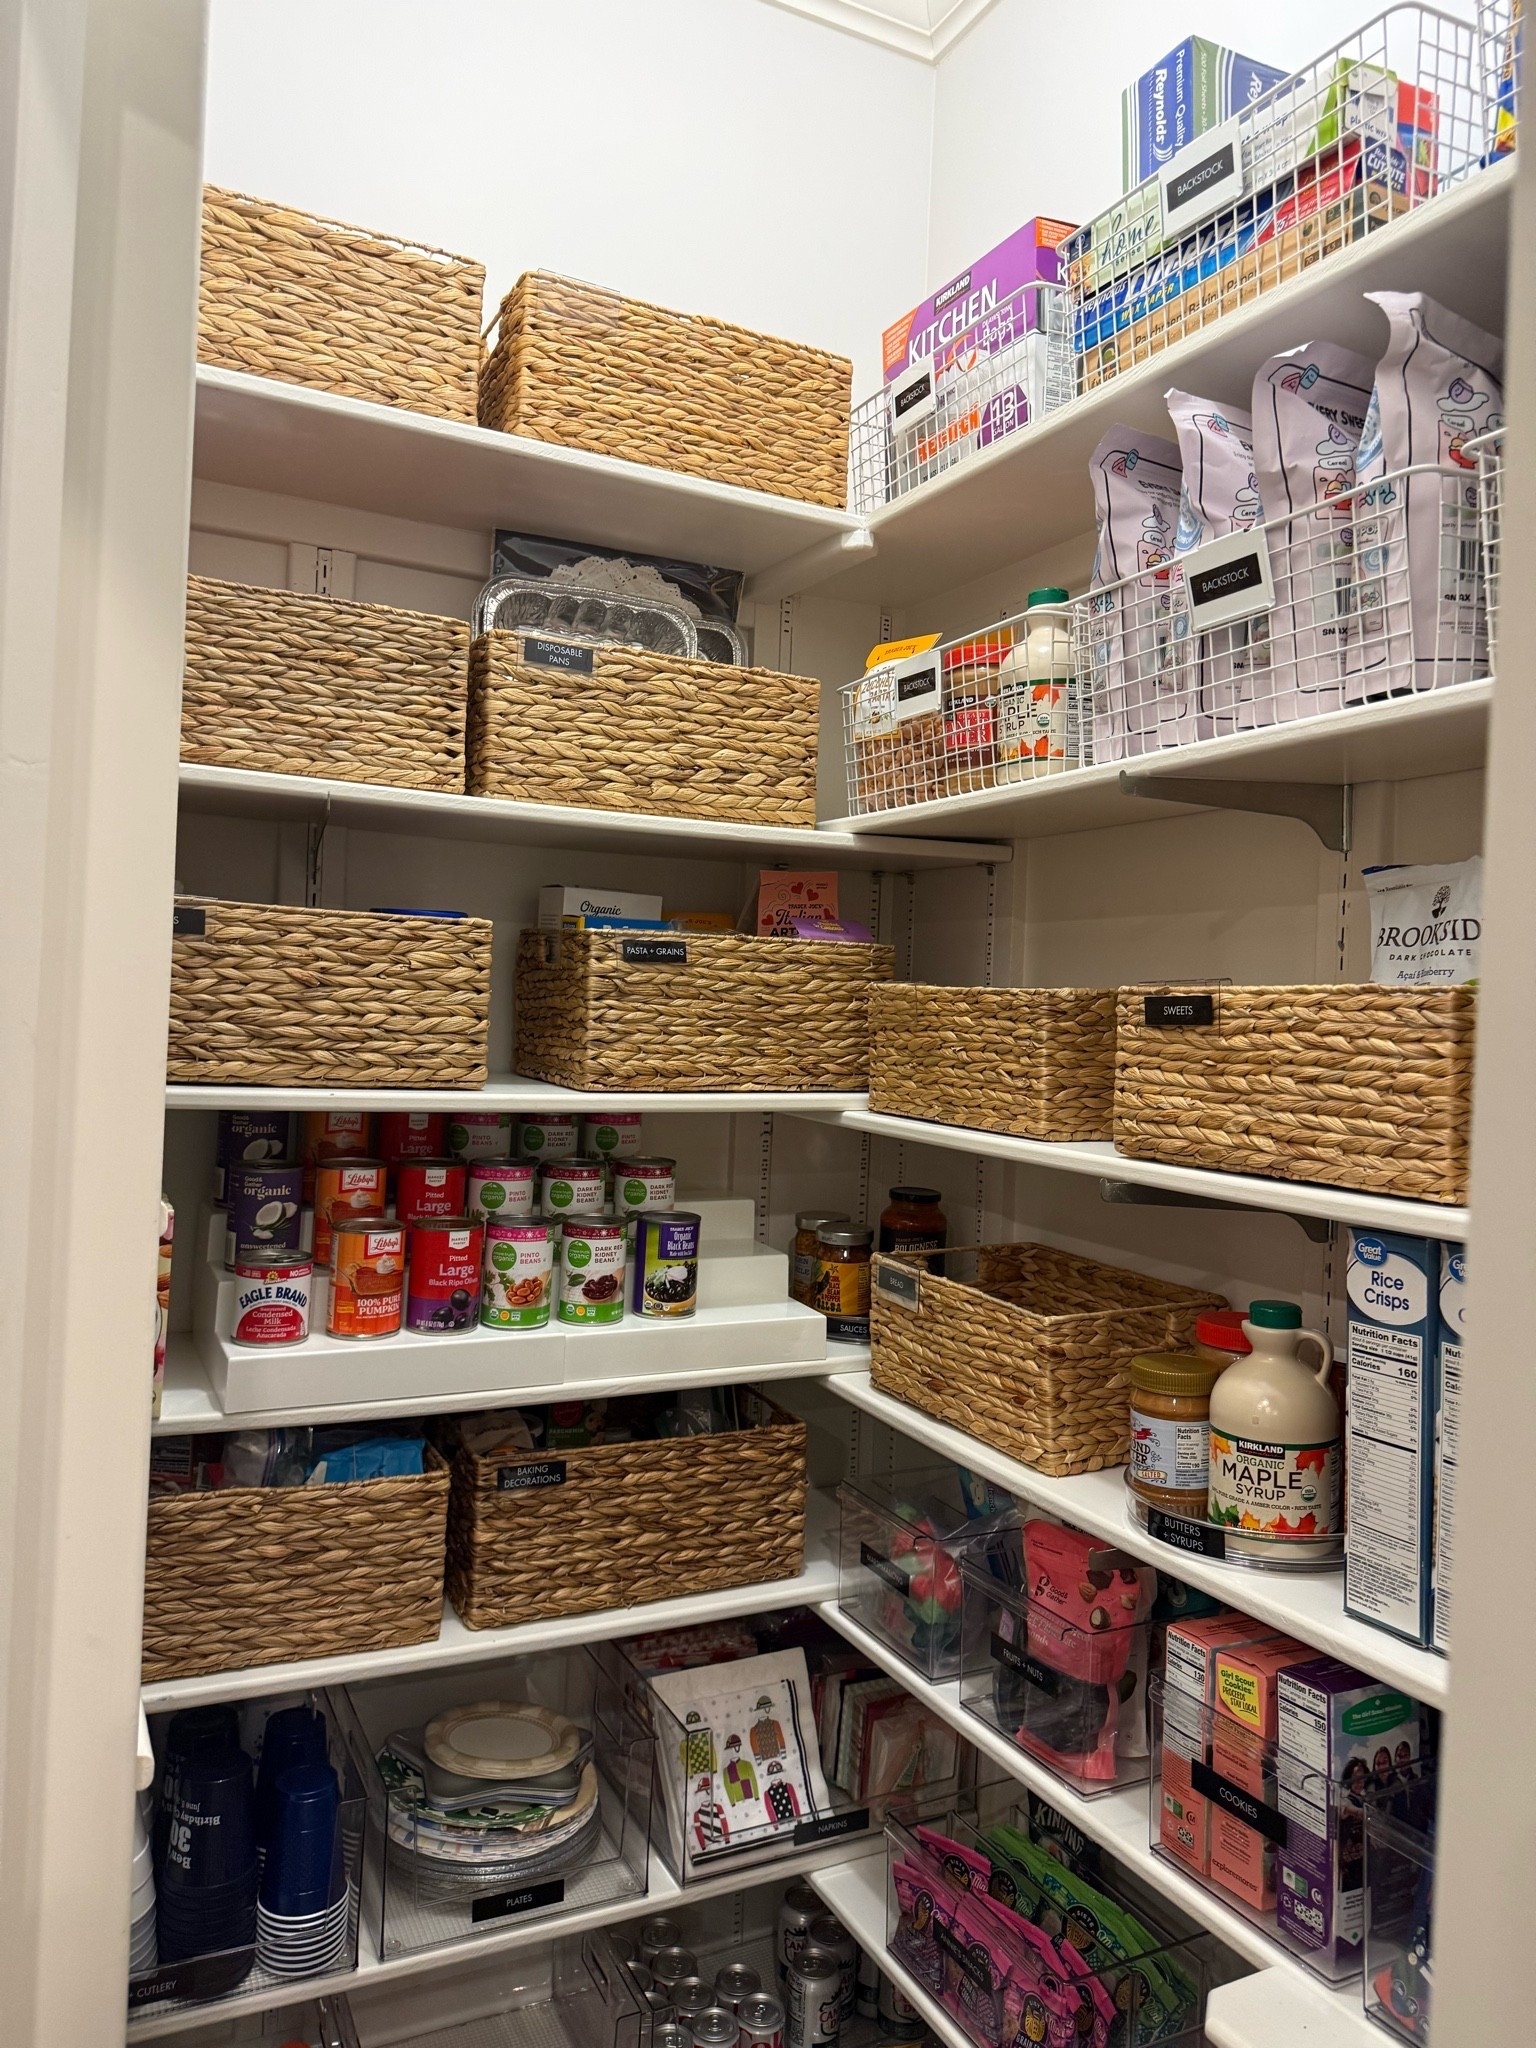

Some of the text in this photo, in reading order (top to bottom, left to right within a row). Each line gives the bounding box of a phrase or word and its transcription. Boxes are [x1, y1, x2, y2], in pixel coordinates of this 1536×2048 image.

[1174, 48, 1186, 146] Premium Quality
[1155, 68, 1167, 146] Reynolds
[1177, 160, 1224, 196] BACKSTOCK
[1101, 213, 1158, 265] home
[936, 275, 970, 307] KIRKLAND
[1080, 280, 1128, 315] Reynolds
[908, 278, 997, 365] KITCHEN
[900, 384, 926, 408] BACKSTOCK
[992, 391, 1015, 427] 13
[1149, 534, 1162, 543] Cereal
[1202, 566, 1250, 593] BACKSTOCK
[536, 641, 584, 658] DISPOSABLE
[549, 654, 570, 666] PANS
[903, 677, 930, 692] BACKSTOCK
[580, 900, 621, 917] Organic
[1376, 919, 1481, 947] BROOKSID
[626, 946, 648, 955] PASTA
[656, 946, 685, 956] GRAINS
[1163, 1004, 1194, 1017] SWEETS
[334, 1116, 360, 1127] Libby's
[231, 1124, 277, 1137] organic
[400, 1143, 433, 1155] Large
[346, 1173, 375, 1185] Libby's
[244, 1185, 292, 1200] organic
[624, 1191, 646, 1199] organic
[416, 1200, 451, 1213] Large
[373, 1236, 400, 1250] Libby's
[674, 1231, 692, 1242] Organic
[240, 1242, 286, 1250] unsweetened
[667, 1240, 695, 1250] Black Beans
[895, 1240, 938, 1252] BOLOGNESE
[1358, 1244, 1381, 1256] Great
[492, 1253, 516, 1262] organic
[1363, 1251, 1382, 1261] Value
[439, 1263, 474, 1278] Large
[428, 1278, 463, 1287] Black Ripe
[890, 1277, 904, 1289] BREAD
[1371, 1270, 1404, 1290] Rice
[239, 1287, 272, 1308] EAGLE
[276, 1287, 308, 1308] BRAND
[357, 1295, 401, 1307] 100% PURE
[825, 1294, 840, 1302] PEPPER
[1364, 1288, 1410, 1311] Crisps
[252, 1310, 293, 1318] Condensed
[358, 1304, 400, 1315] PUMPKIN
[264, 1317, 282, 1325] Milk
[840, 1324, 868, 1334] SAUCES
[1352, 1325, 1389, 1341] Nutrition
[1391, 1335, 1418, 1347] Facts
[1352, 1341, 1368, 1350] Serving
[1352, 1357, 1381, 1370] Calories
[1397, 1367, 1417, 1379] 160
[1238, 1440, 1284, 1454] KIRKLAND
[517, 1464, 549, 1475] BAKING
[1236, 1454, 1285, 1470] ORGANIC
[504, 1473, 561, 1488] DECORATIONS
[1222, 1460, 1303, 1489] MAPLE
[1235, 1485, 1286, 1501] SYRUP
[1228, 1494, 1244, 1502] GRADE
[1250, 1500, 1267, 1508] AMBER
[1268, 1503, 1290, 1511] COLOR
[1164, 1516, 1201, 1537] BUTTERS
[1170, 1532, 1204, 1552] SYRUPS
[1046, 1591, 1066, 1605] Gather
[1049, 1585, 1069, 1599] Good&
[1168, 1631, 1191, 1649] Nutrition
[1191, 1644, 1206, 1657] Facts
[1003, 1648, 1022, 1668] FRUITS
[1027, 1664, 1044, 1682] NUTS
[1167, 1657, 1182, 1670] Calories
[1194, 1670, 1204, 1682] 130
[1220, 1669, 1255, 1688] Girl Scout
[1222, 1686, 1246, 1701] PROCEEDS
[1278, 1675, 1307, 1695] Nutrition
[1307, 1689, 1327, 1703] Facts
[1230, 1698, 1258, 1714] STAY LOCAL
[1279, 1702, 1299, 1718] Calories
[1362, 1710, 1370, 1718] Girl
[1314, 1718, 1326, 1731] 150
[186, 1803, 201, 1813] June
[1219, 1787, 1259, 1818] COOKIES
[180, 1810, 221, 1826] Birthday
[818, 1819, 848, 1834] NAPKINS
[171, 1820, 192, 1853] 30
[1212, 1857, 1258, 1892] exploremores
[506, 1893, 533, 1906] PLATES
[1077, 1910, 1095, 1927] SIETE
[137, 1980, 177, 1998] CUTLERY
